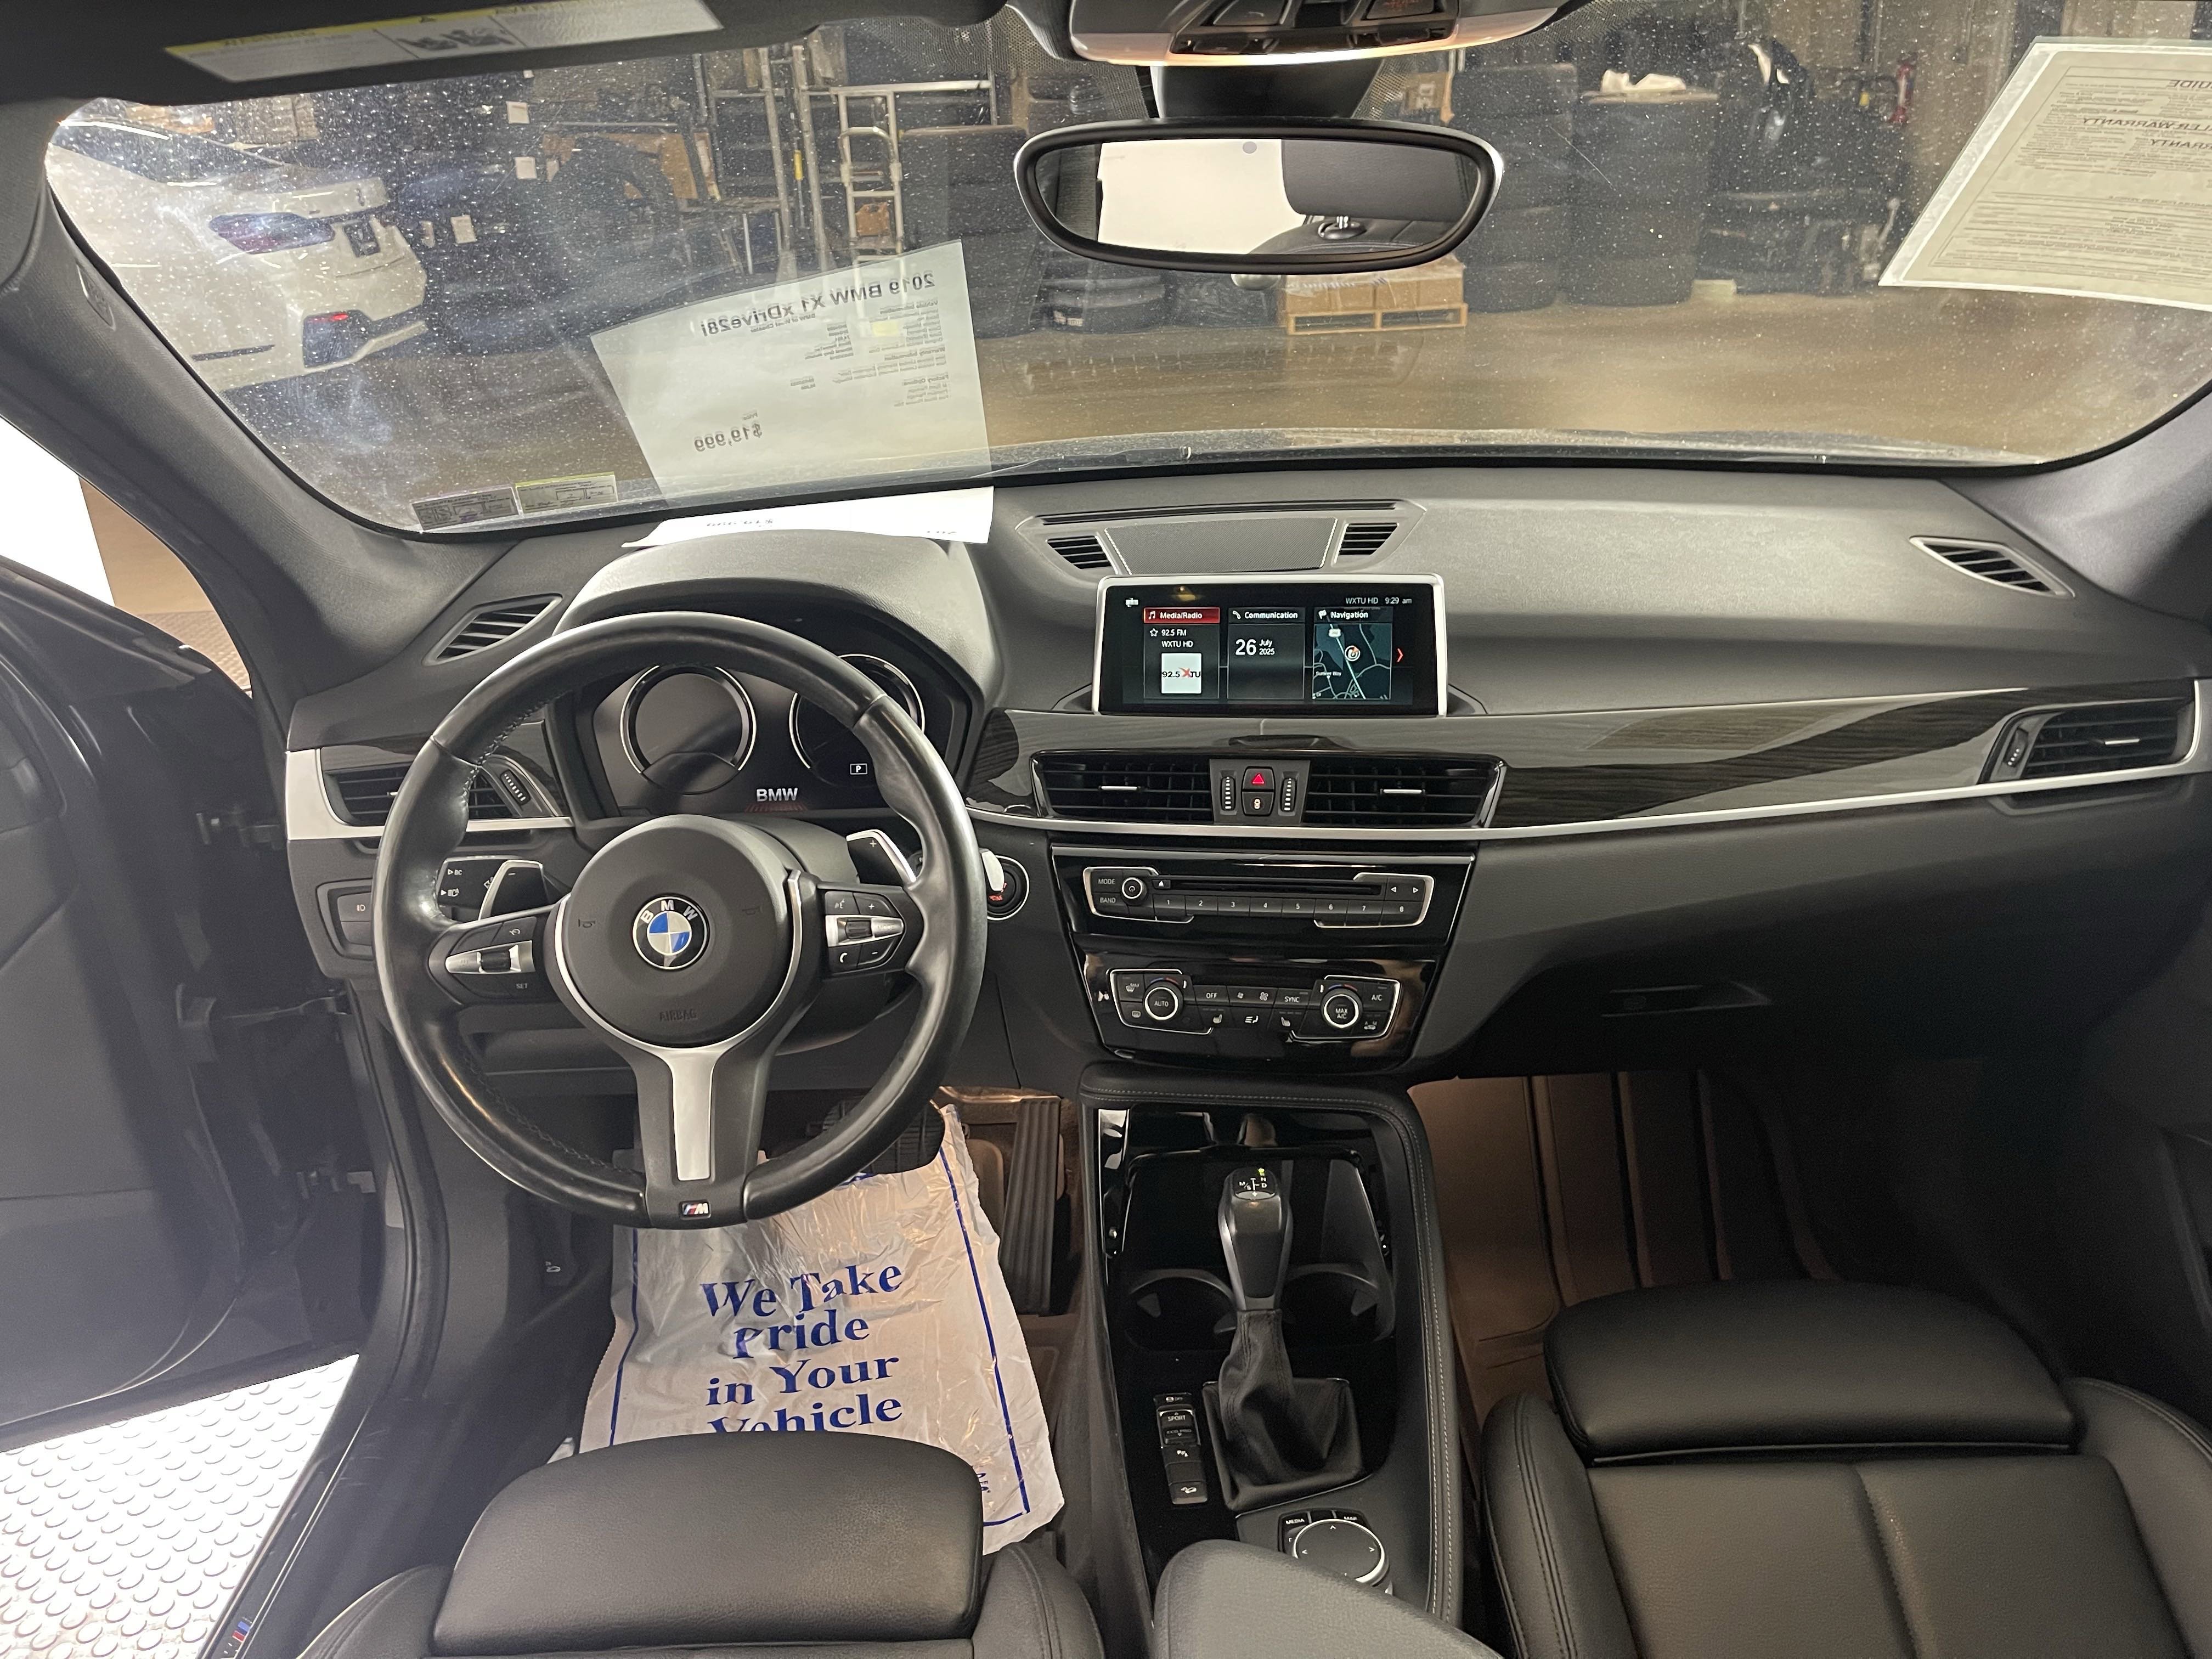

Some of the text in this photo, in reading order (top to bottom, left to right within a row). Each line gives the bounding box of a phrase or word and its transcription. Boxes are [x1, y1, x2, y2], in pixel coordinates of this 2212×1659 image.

[1330, 611, 1368, 619] Navigation
[1235, 639, 1257, 656] 26
[856, 765, 862, 773] P
[756, 788, 798, 802] BMW
[640, 900, 698, 924] BMW
[659, 1009, 696, 1020] AIRBAG
[700, 1265, 902, 1317] We Take
[733, 1309, 870, 1359] Pride
[706, 1357, 900, 1406] in Your
